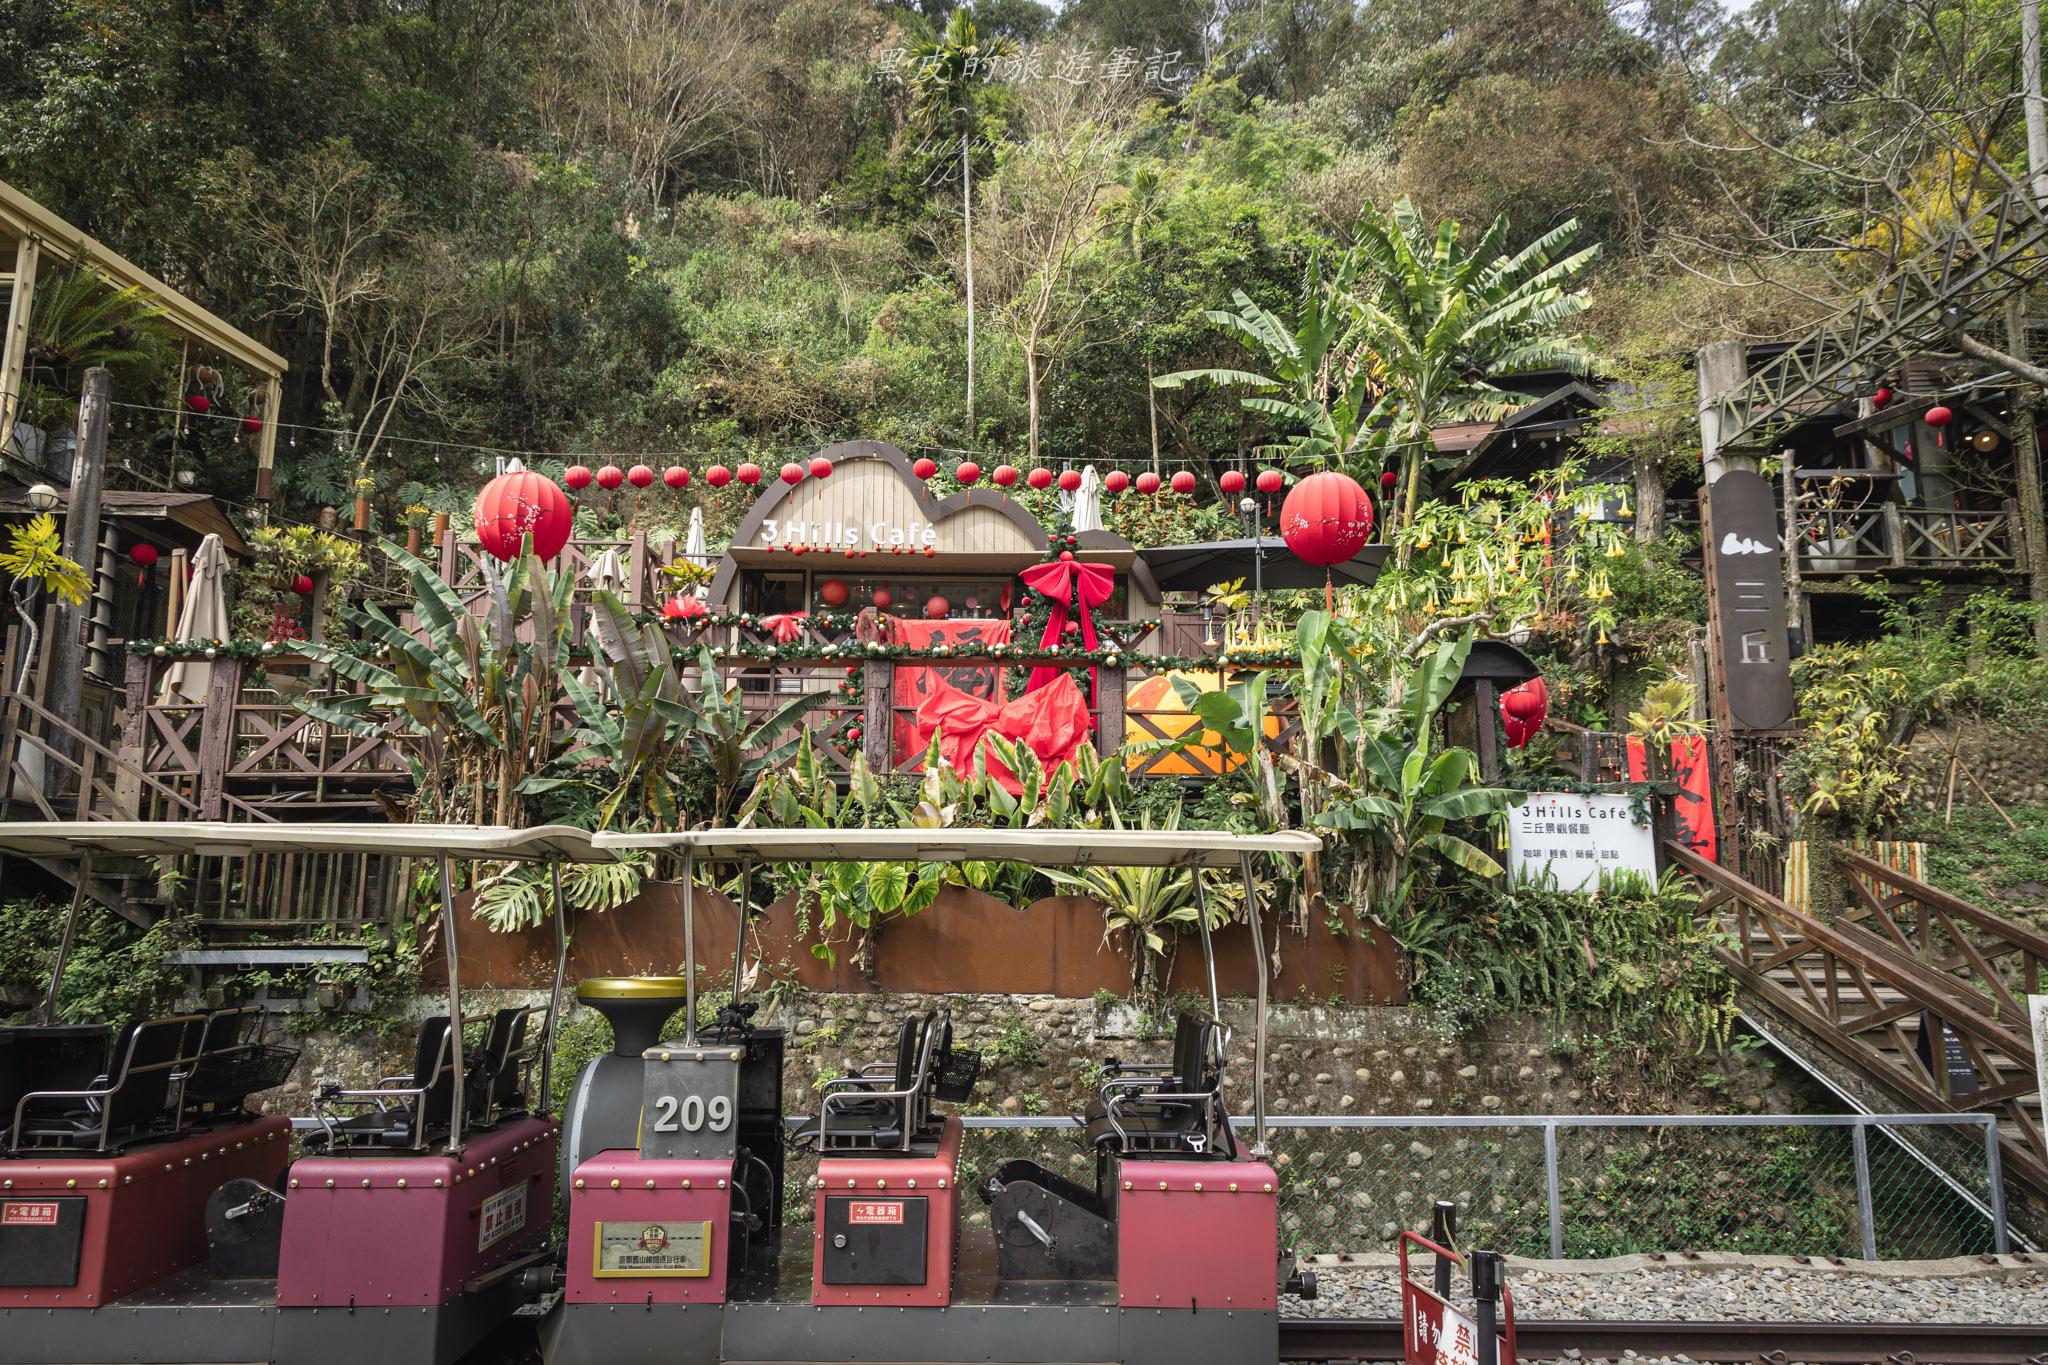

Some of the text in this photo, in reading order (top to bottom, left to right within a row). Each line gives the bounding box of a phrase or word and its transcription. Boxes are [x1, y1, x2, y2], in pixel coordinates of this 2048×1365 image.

[760, 519, 778, 543] 3
[871, 522, 937, 546] Café
[1735, 581, 1775, 664] 三丘
[1522, 806, 1530, 817] 3
[1588, 807, 1626, 819] Café
[1522, 822, 1590, 834] 三丘景觀餐廳
[1523, 849, 1619, 859] 咖啡 輕食 簡餐 甜點
[654, 1095, 732, 1132] 209
[20, 1206, 51, 1216] 電器箱
[866, 1205, 896, 1216] 電器箱
